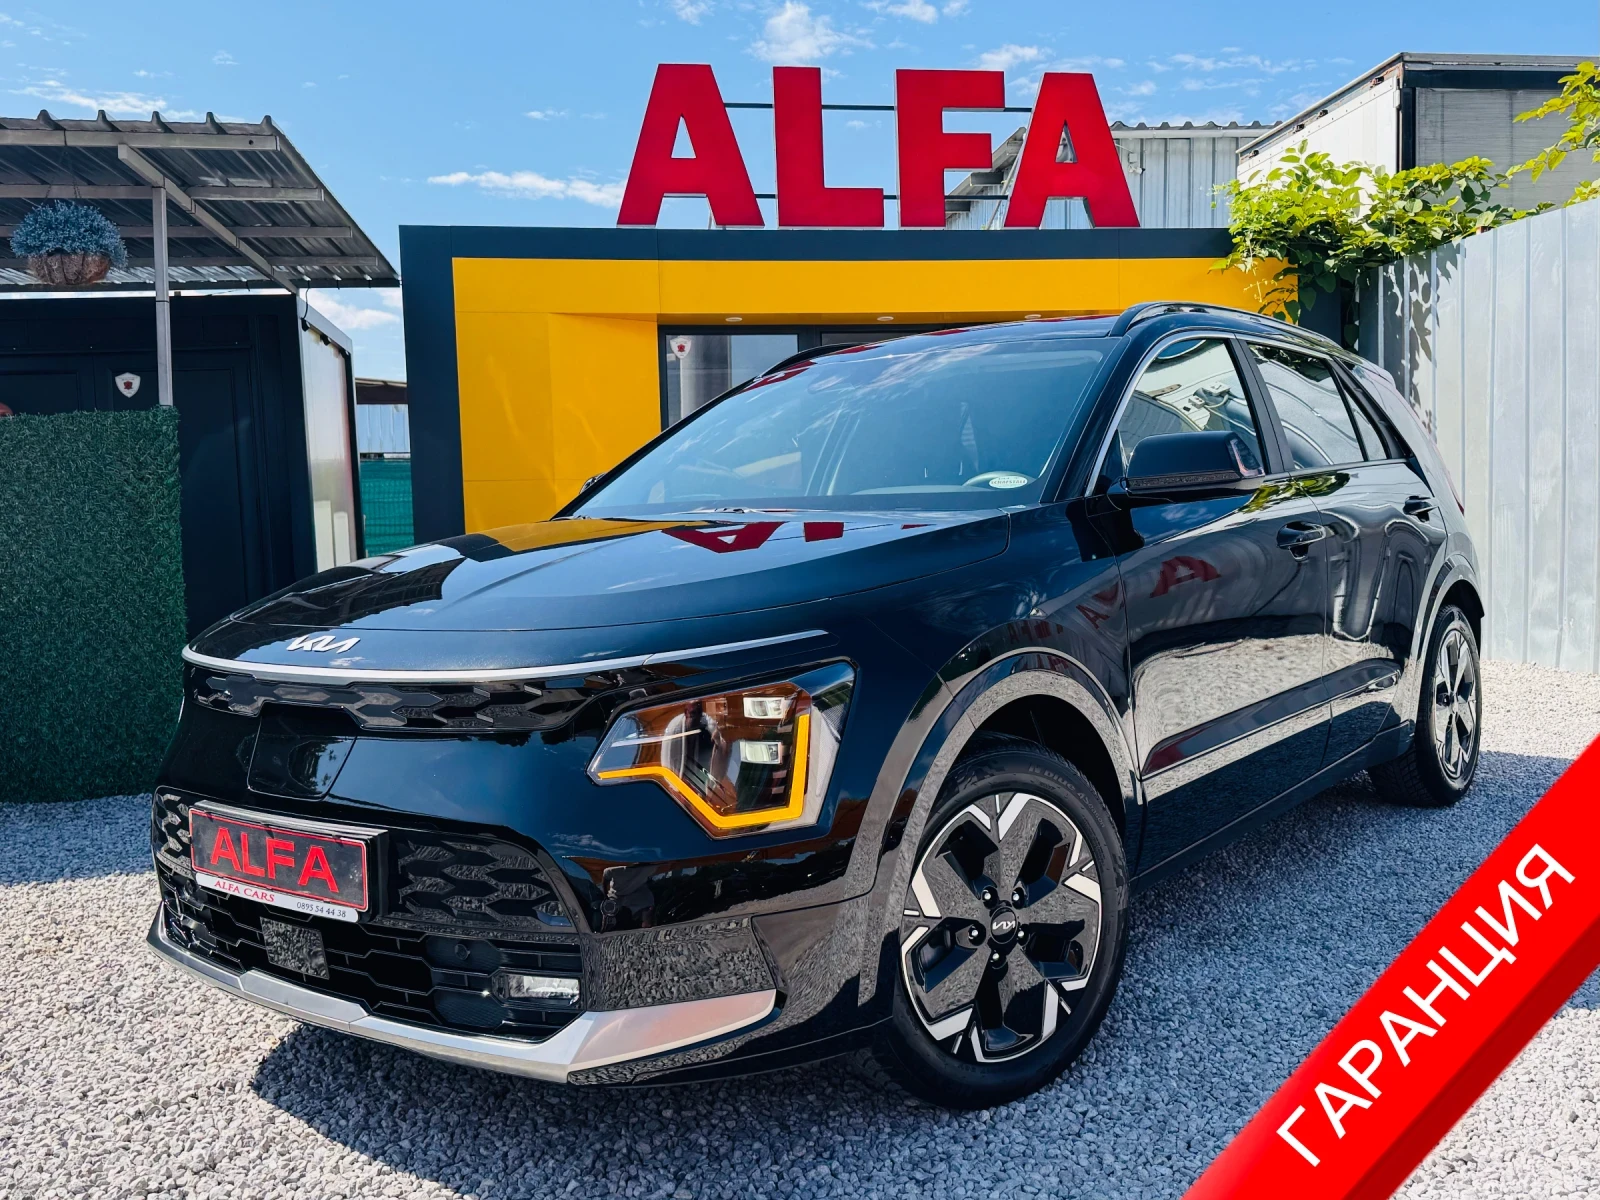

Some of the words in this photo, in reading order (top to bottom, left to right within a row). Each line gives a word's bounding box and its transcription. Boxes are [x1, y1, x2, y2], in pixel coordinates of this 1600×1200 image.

[616, 63, 1140, 228] ALFA
[286, 635, 361, 654] KIA
[210, 827, 339, 893] ALFA
[214, 880, 240, 894] ALFA
[243, 887, 275, 902] CARS
[296, 901, 314, 912] 0895
[315, 905, 324, 914] 54
[325, 907, 335, 916] 44
[336, 909, 347, 918] 38
